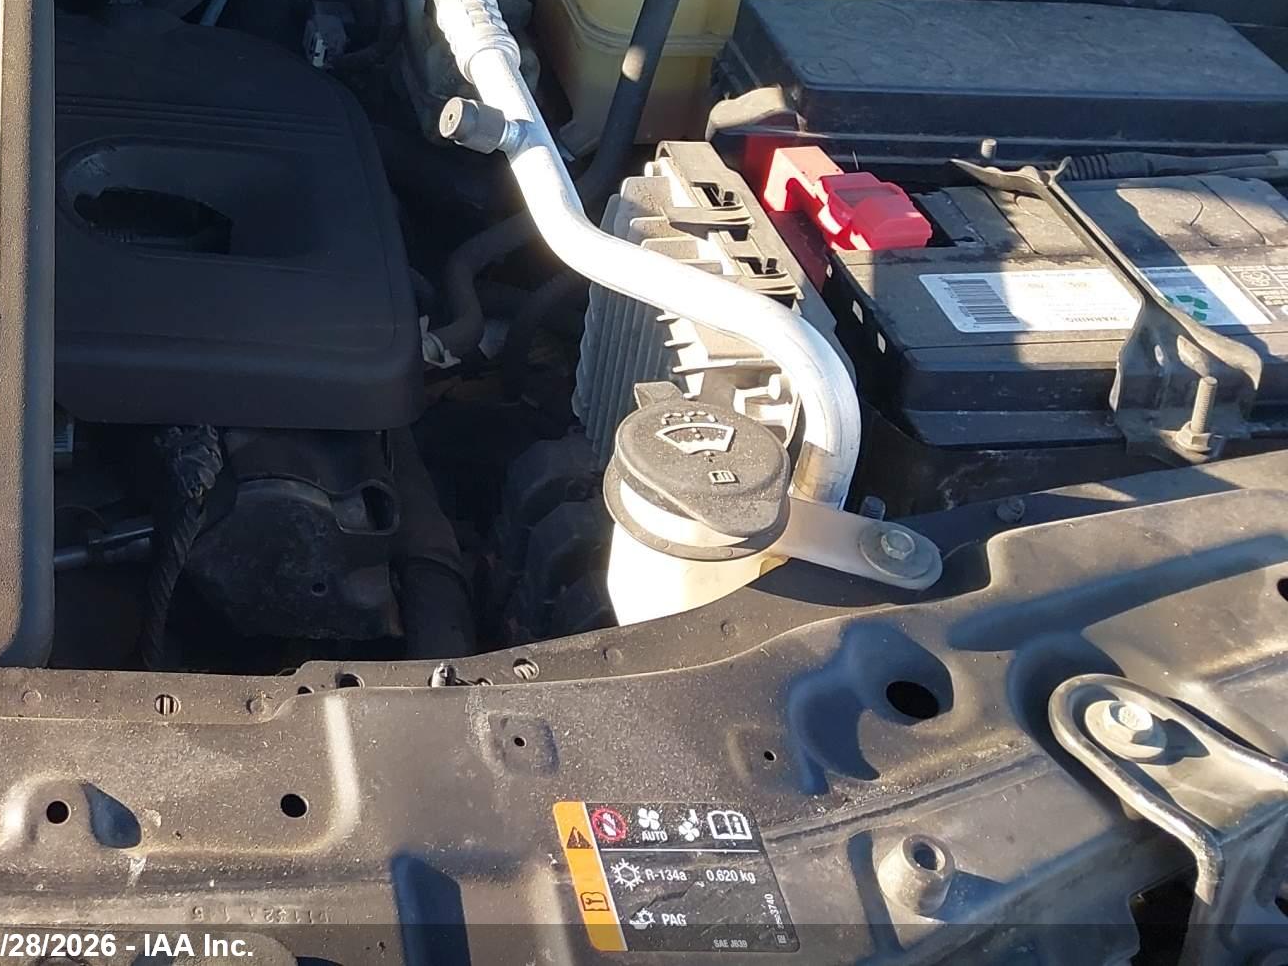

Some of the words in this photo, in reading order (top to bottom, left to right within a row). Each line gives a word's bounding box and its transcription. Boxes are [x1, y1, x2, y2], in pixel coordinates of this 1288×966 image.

[641, 829, 668, 842] AUTO
[644, 867, 688, 882] R-134a
[705, 868, 739, 882] 0.620
[740, 869, 756, 885] kg
[661, 912, 688, 927] PAG
[713, 938, 730, 948] SAE
